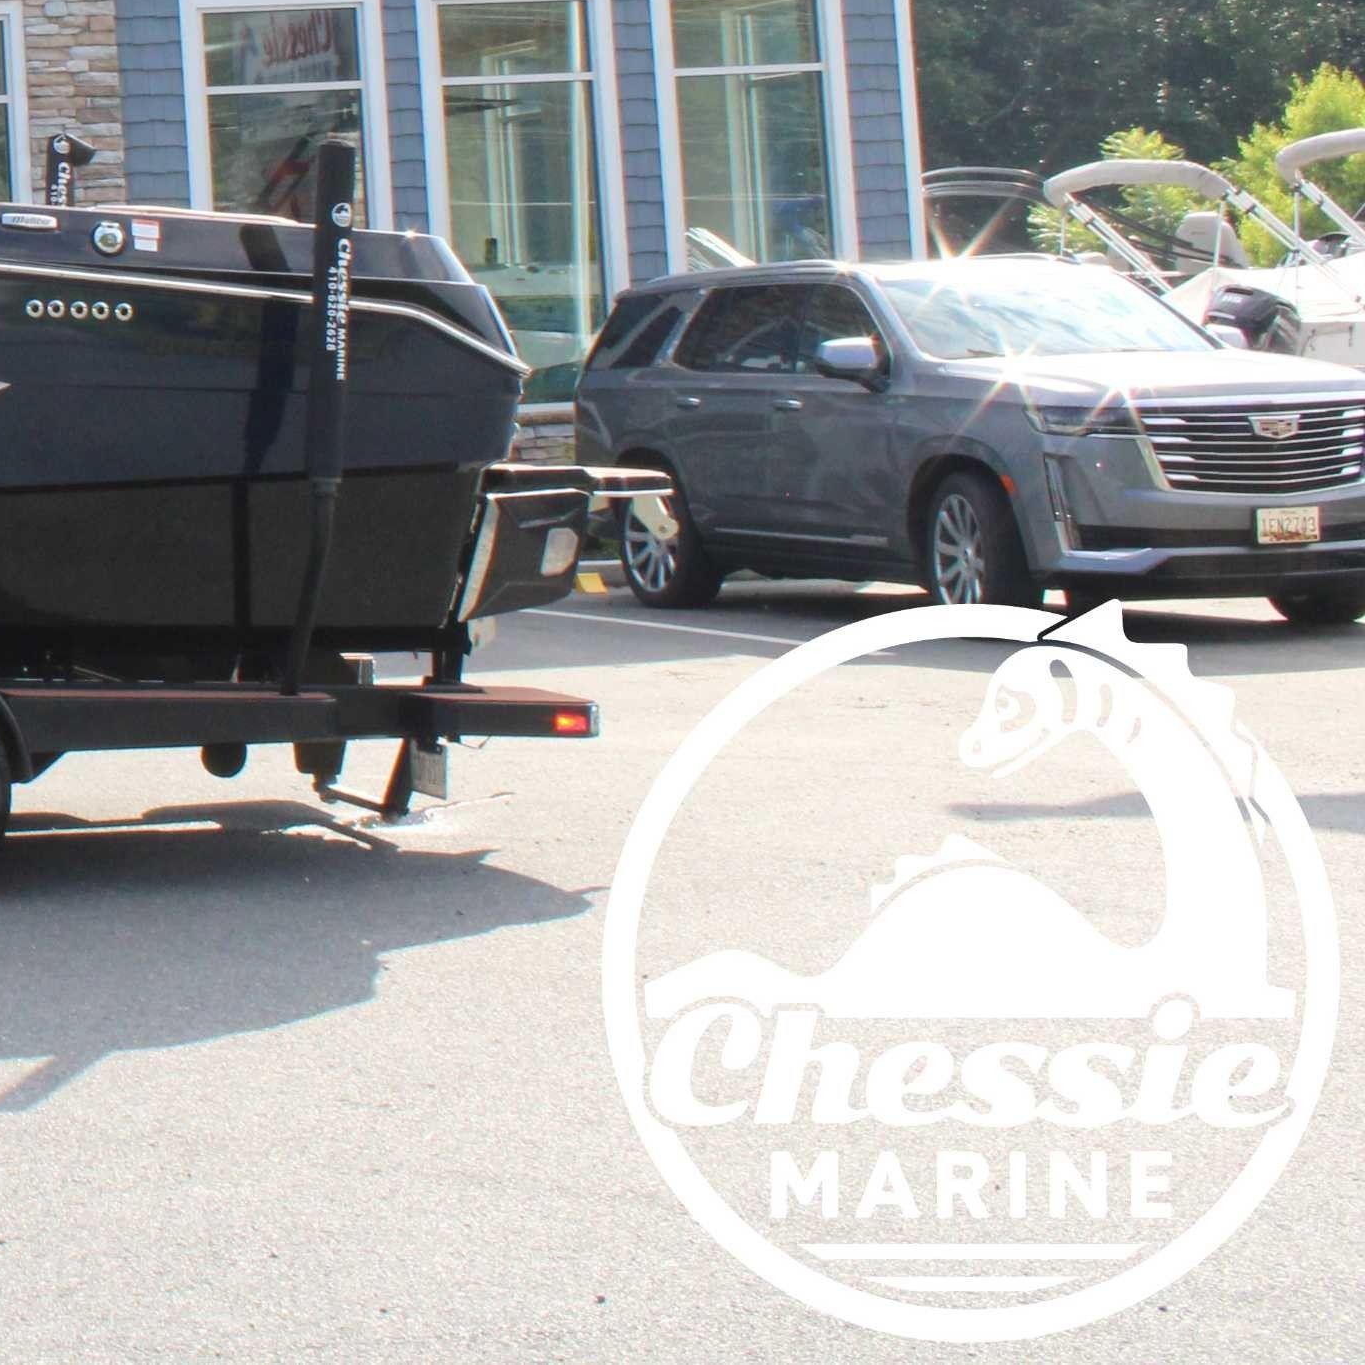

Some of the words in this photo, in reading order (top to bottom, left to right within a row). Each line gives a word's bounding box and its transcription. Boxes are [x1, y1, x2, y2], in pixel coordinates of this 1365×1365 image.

[57, 161, 71, 206] Ches
[336, 238, 352, 325] Chessie
[335, 328, 347, 381] MARINE
